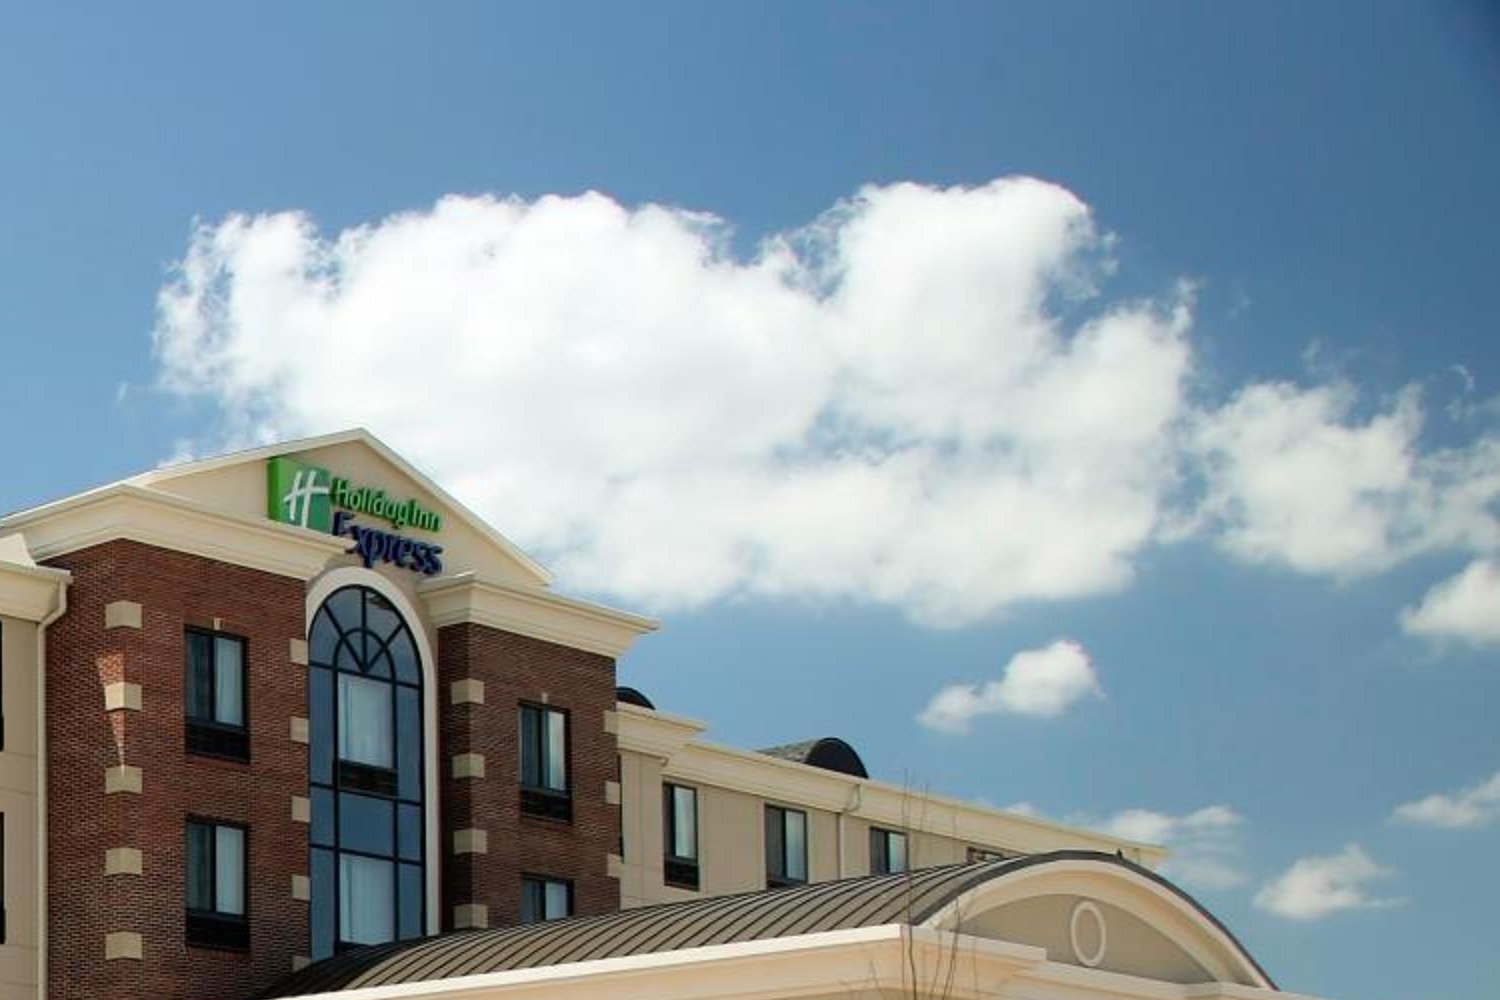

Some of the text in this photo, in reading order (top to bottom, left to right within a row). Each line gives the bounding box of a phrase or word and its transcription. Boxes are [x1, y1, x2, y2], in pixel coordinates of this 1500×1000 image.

[330, 477, 443, 532] Holiday Inn
[332, 510, 444, 575] Express
